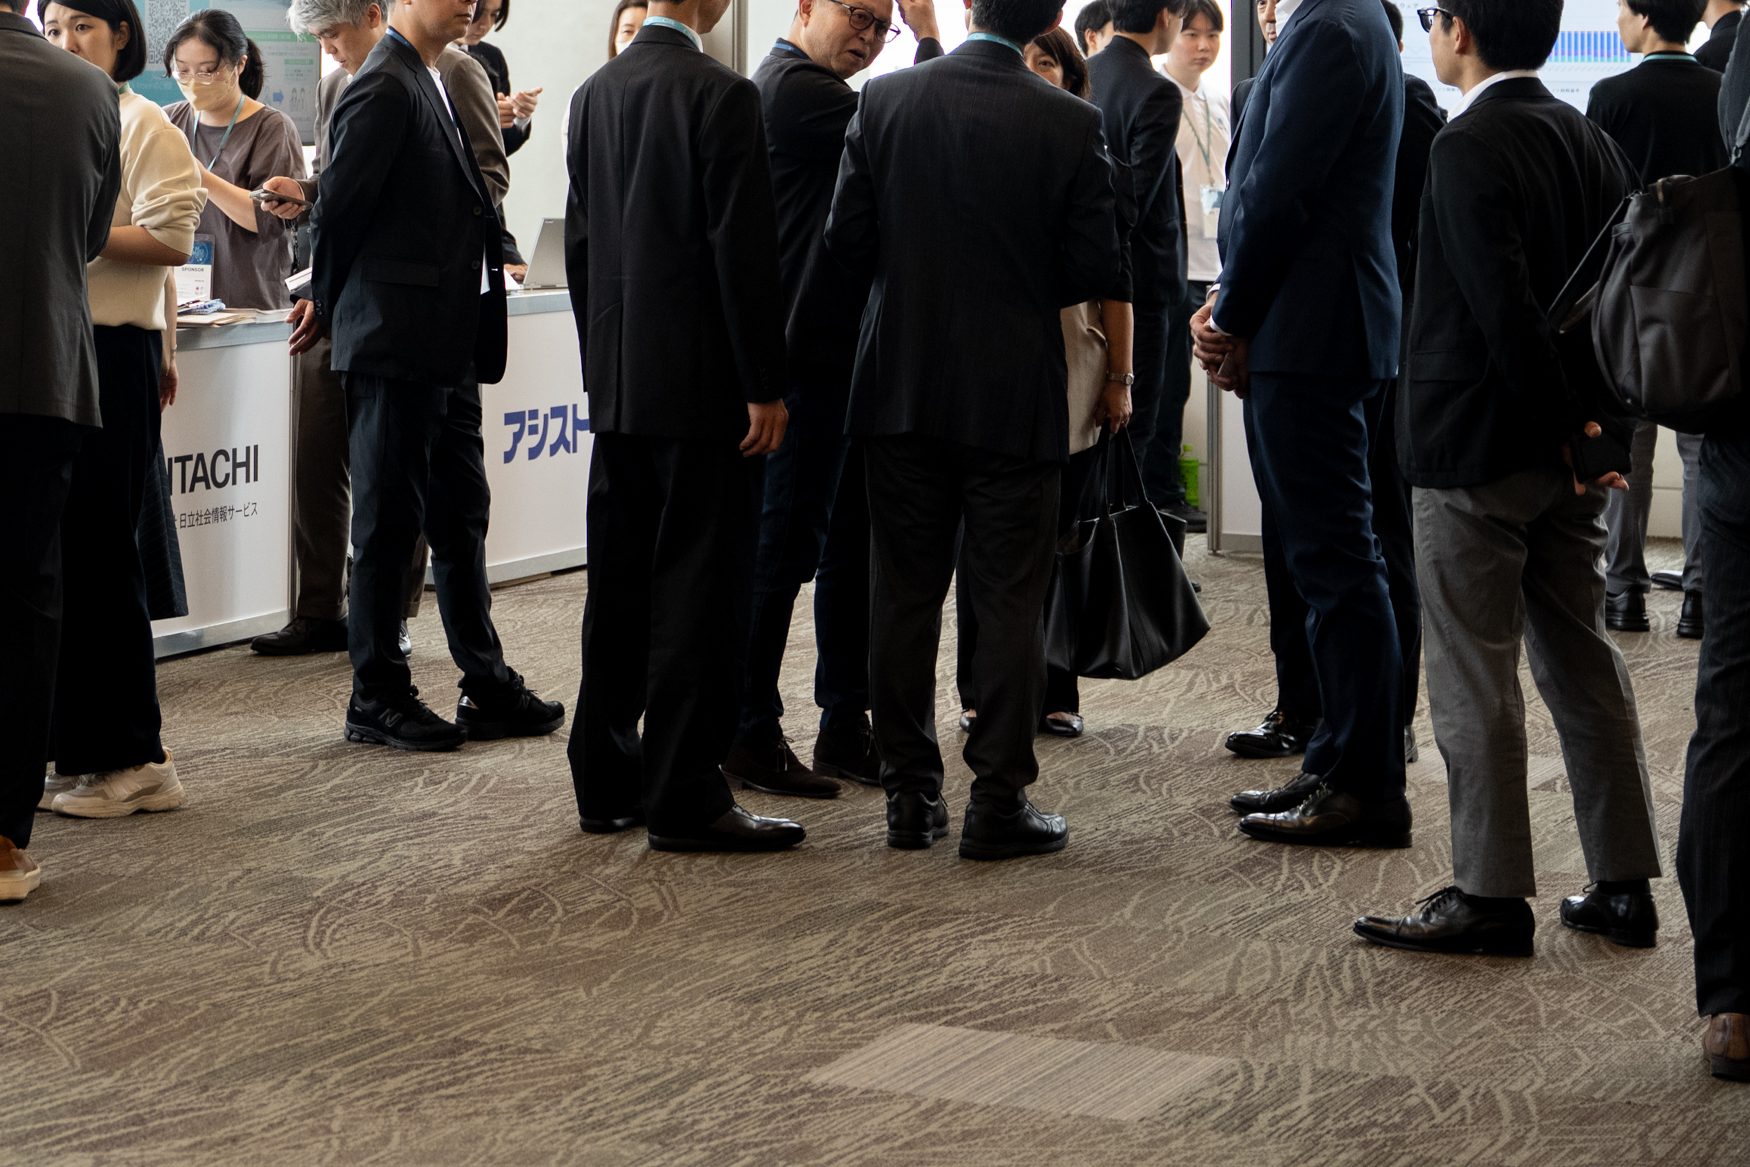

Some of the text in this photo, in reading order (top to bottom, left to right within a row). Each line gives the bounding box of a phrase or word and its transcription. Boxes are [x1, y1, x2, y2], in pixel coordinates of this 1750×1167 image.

[503, 403, 590, 464] アシスト
[167, 444, 259, 497] ITACHI
